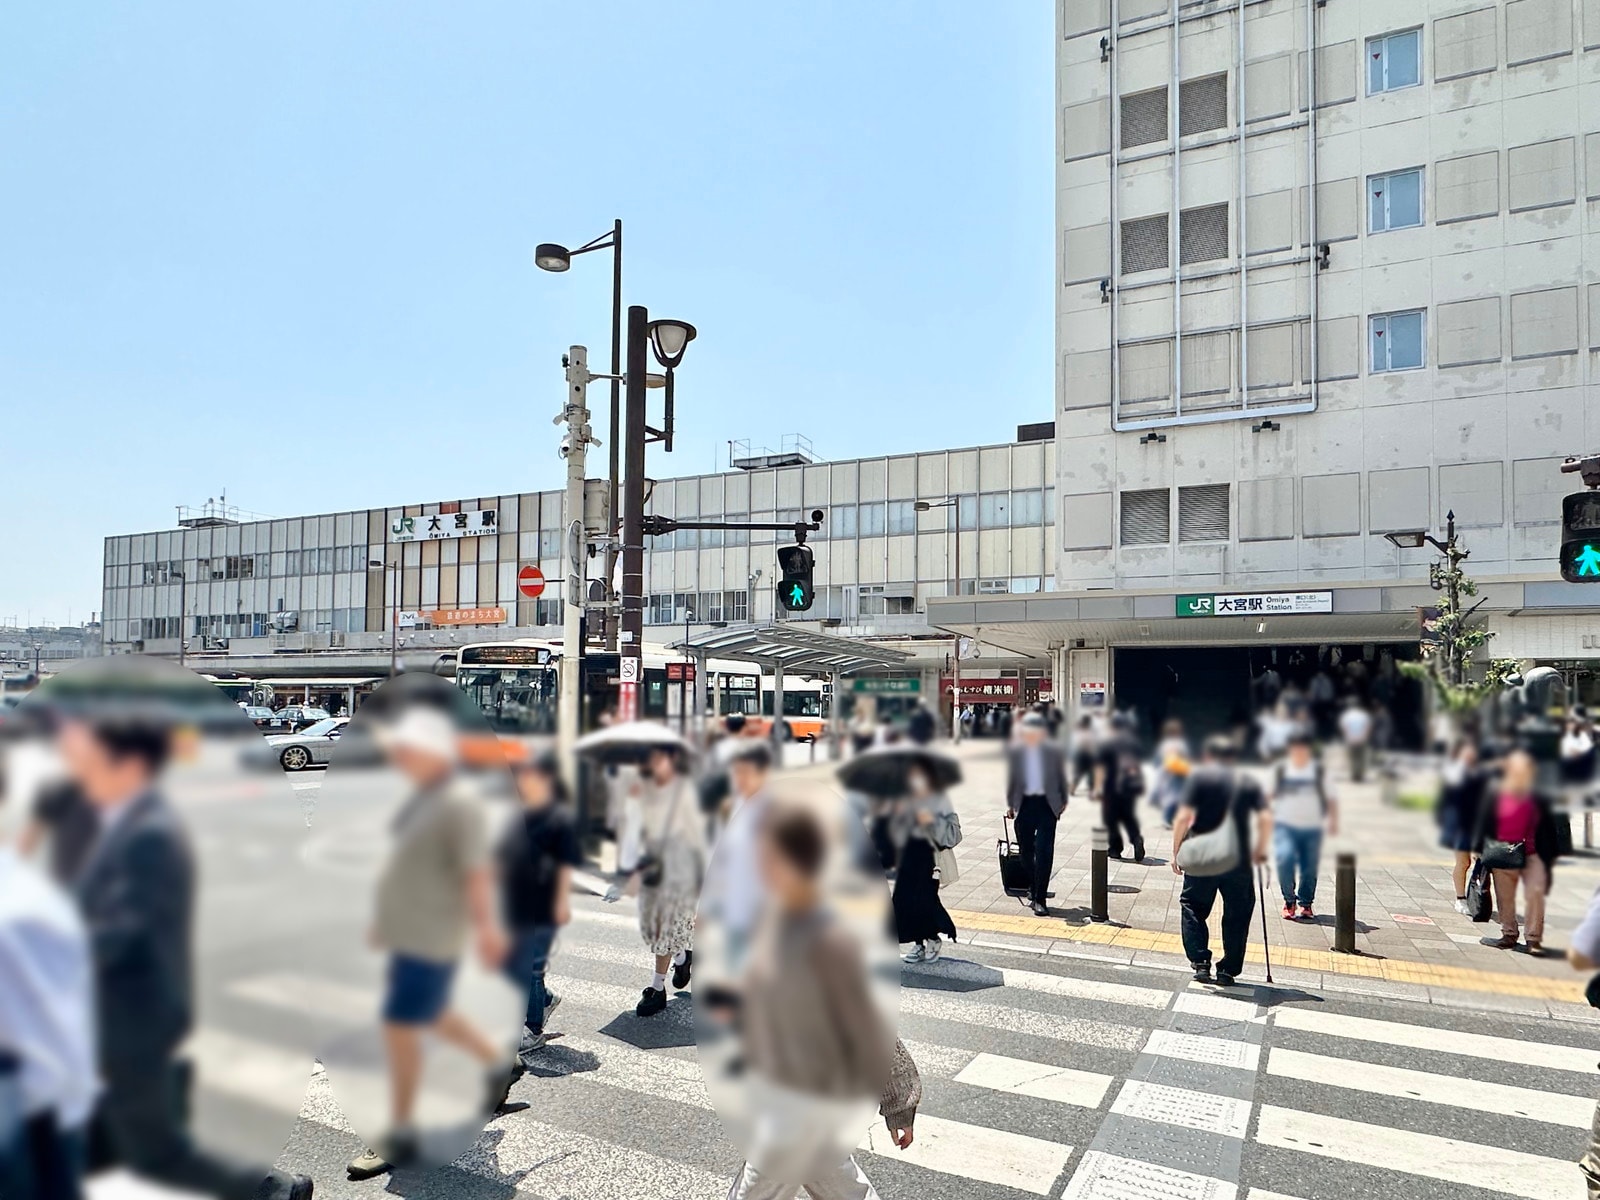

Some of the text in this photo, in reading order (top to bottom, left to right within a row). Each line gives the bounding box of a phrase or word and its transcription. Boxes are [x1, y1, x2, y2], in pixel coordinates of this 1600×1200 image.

[392, 510, 495, 534] JR 大宮駅
[1190, 598, 1262, 611] JR 大宮駅
